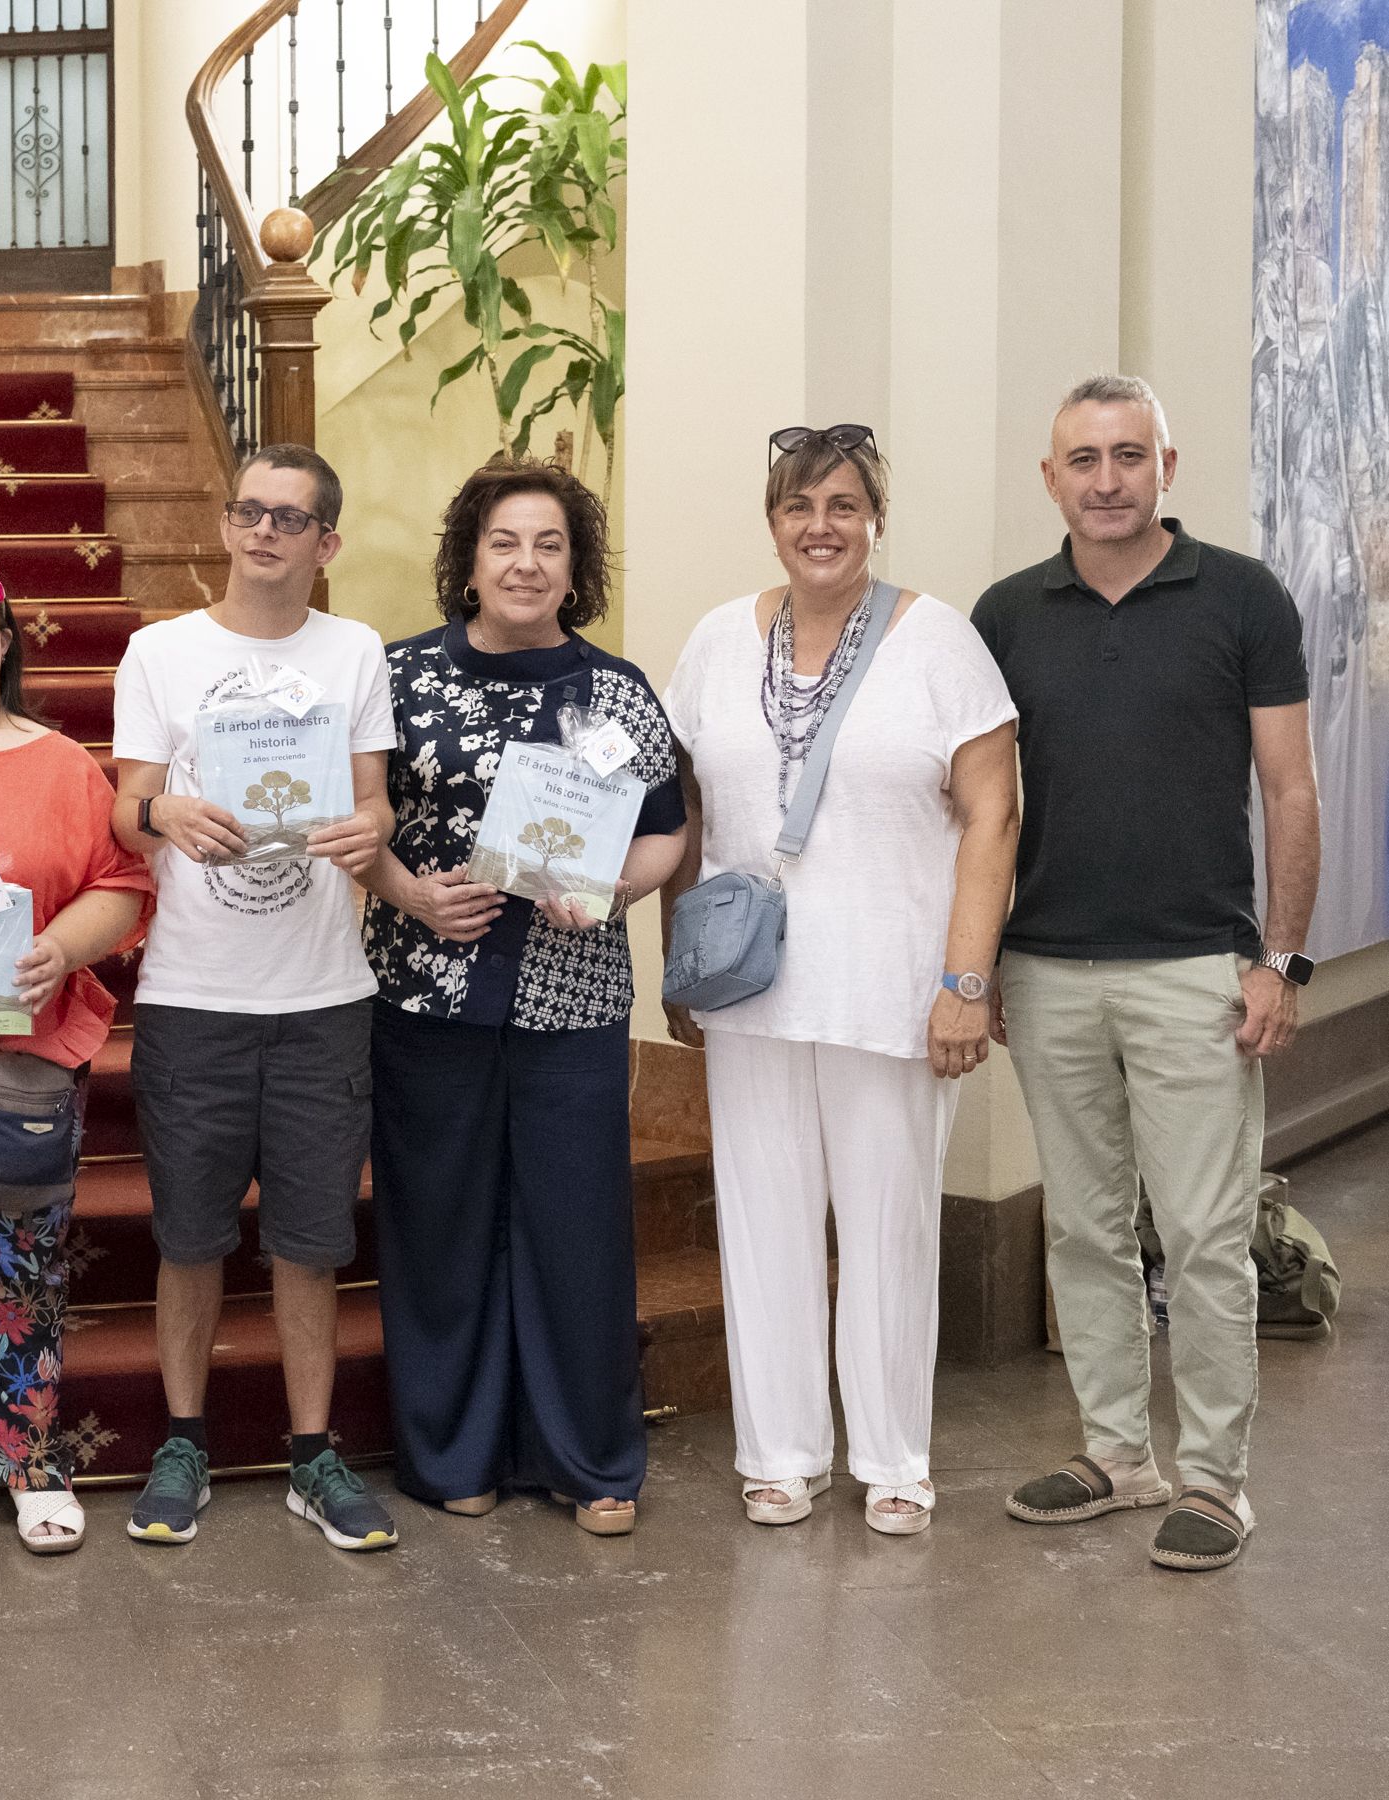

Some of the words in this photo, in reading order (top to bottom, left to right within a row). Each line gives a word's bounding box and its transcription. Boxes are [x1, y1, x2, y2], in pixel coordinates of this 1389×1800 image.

[214, 722, 225, 733] El
[229, 719, 260, 732] árbol
[264, 718, 279, 729] de
[283, 715, 330, 728] nuestra
[250, 735, 297, 749] historia
[243, 756, 252, 764] 25
[253, 755, 270, 763] años
[271, 753, 306, 762] creciendo
[517, 754, 530, 766] El
[532, 758, 563, 777] árbol
[565, 770, 580, 782] de
[583, 776, 628, 797] nuestra
